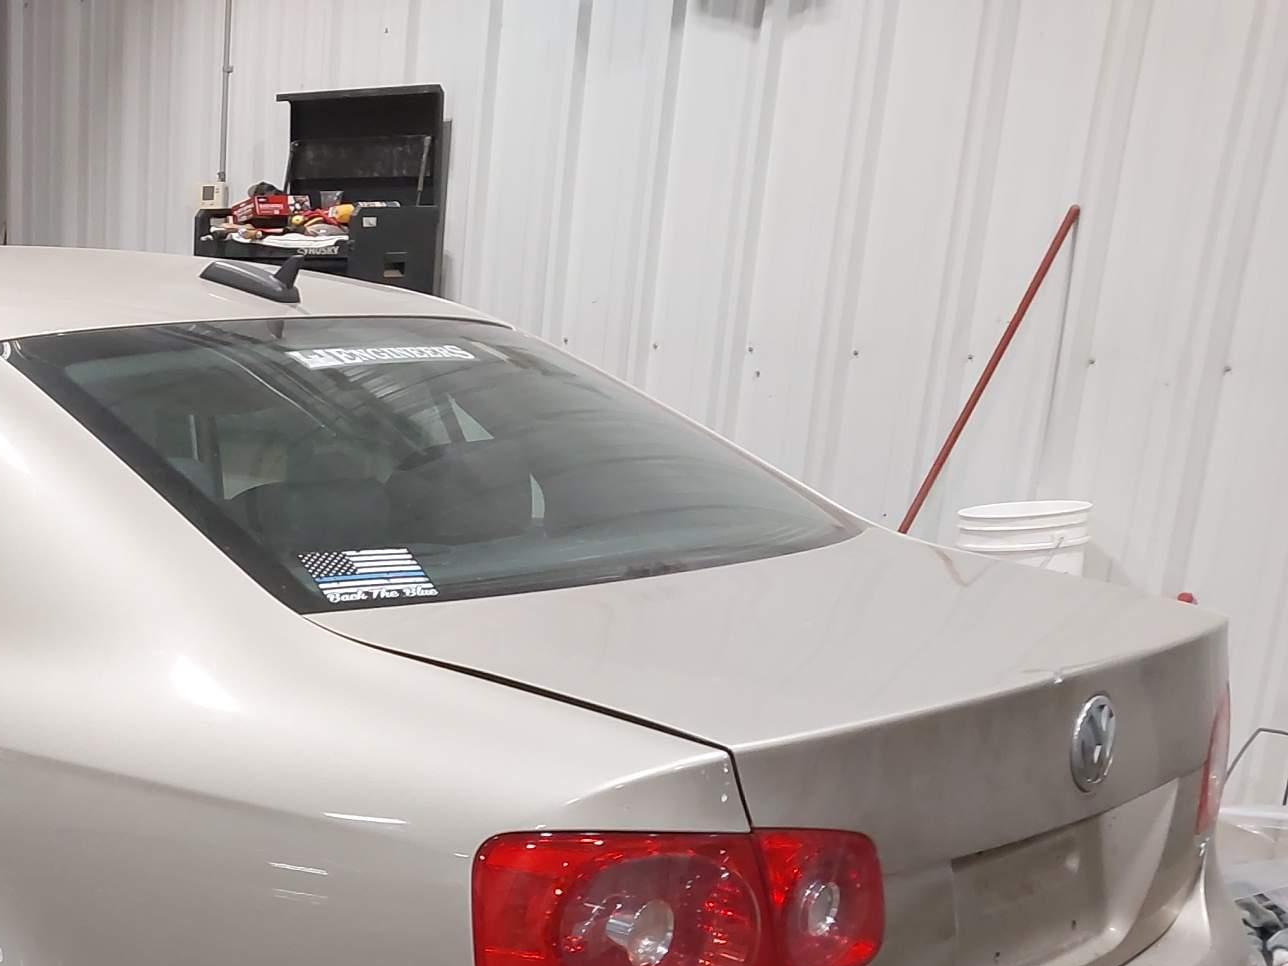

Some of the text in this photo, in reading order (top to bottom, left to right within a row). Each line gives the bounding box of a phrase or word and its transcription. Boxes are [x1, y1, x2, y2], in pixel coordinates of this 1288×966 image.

[309, 246, 339, 255] HUSKY
[335, 345, 476, 364] ENGINEERS
[326, 584, 440, 604] Back The Blue
